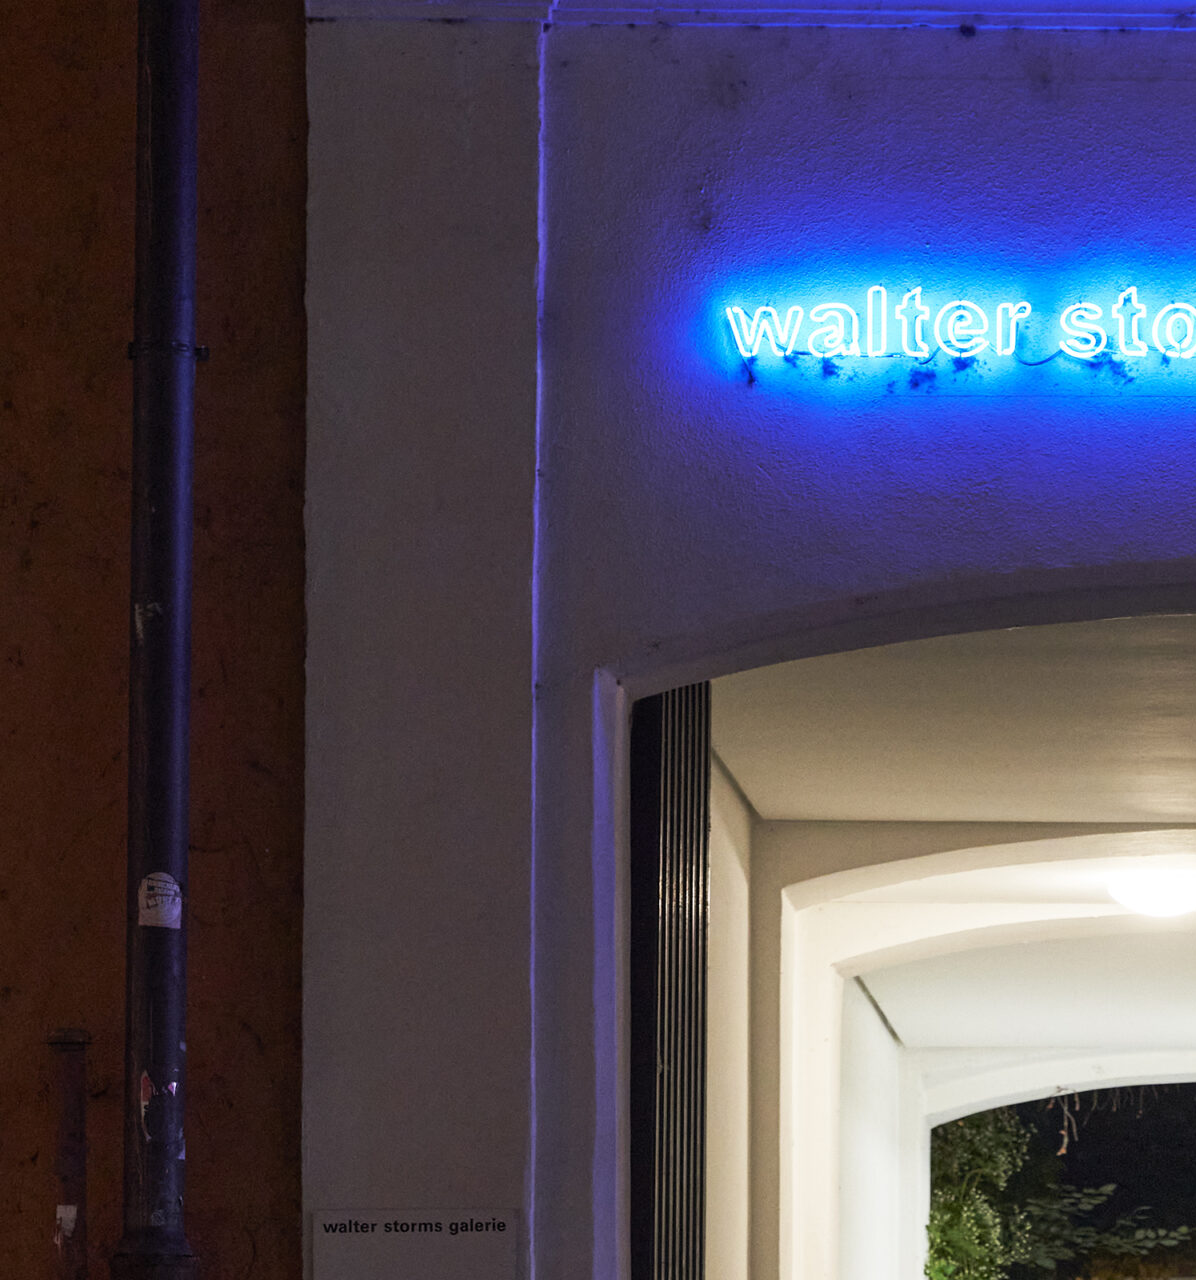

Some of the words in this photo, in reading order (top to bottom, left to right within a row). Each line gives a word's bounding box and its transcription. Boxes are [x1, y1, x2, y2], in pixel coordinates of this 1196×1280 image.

[726, 286, 1032, 358] walter
[323, 1219, 377, 1233] walter
[384, 1219, 443, 1233] storms
[449, 1218, 507, 1235] galerie
